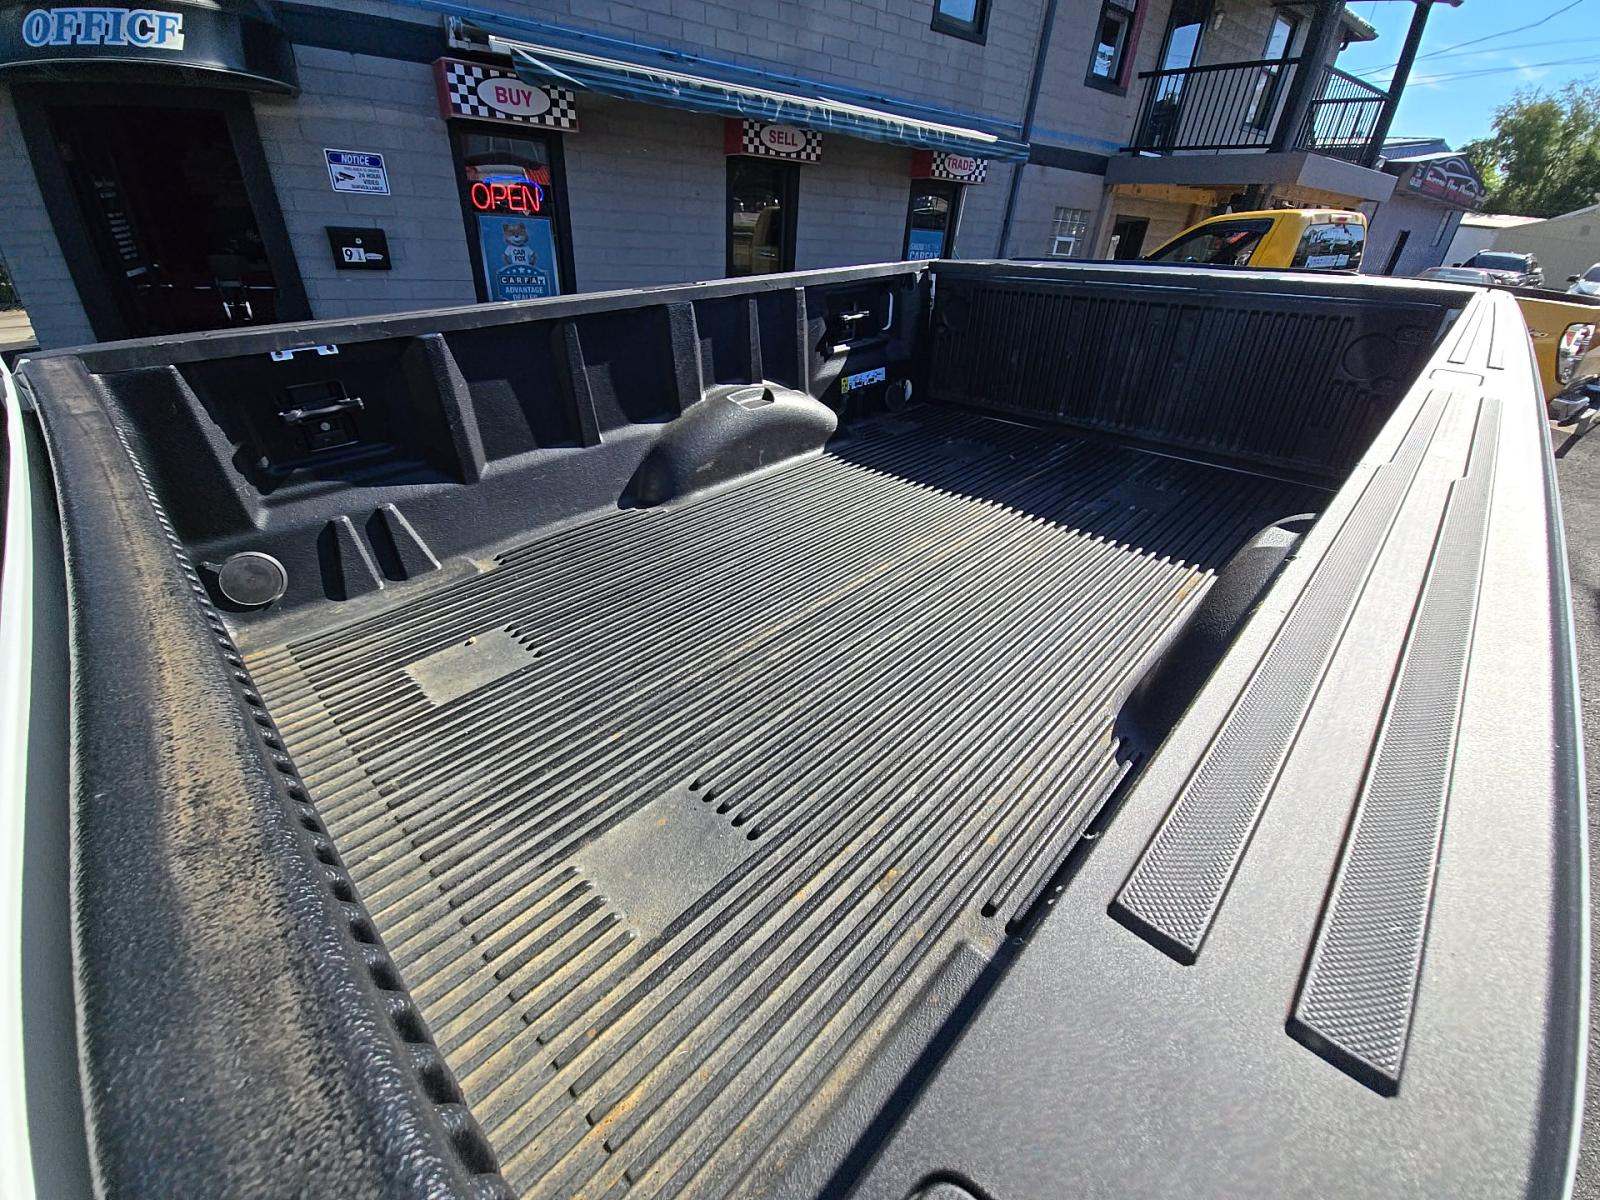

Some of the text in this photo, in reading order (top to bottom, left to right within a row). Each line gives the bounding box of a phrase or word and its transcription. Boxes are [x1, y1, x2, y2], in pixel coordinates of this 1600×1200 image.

[495, 85, 532, 107] BUY
[768, 129, 798, 147] SELL
[341, 154, 370, 166] NOTICE
[948, 157, 974, 172] TRADE
[472, 183, 540, 211] OPEN
[501, 276, 546, 285] CARFAX
[505, 286, 544, 294] ADVANTAGE
